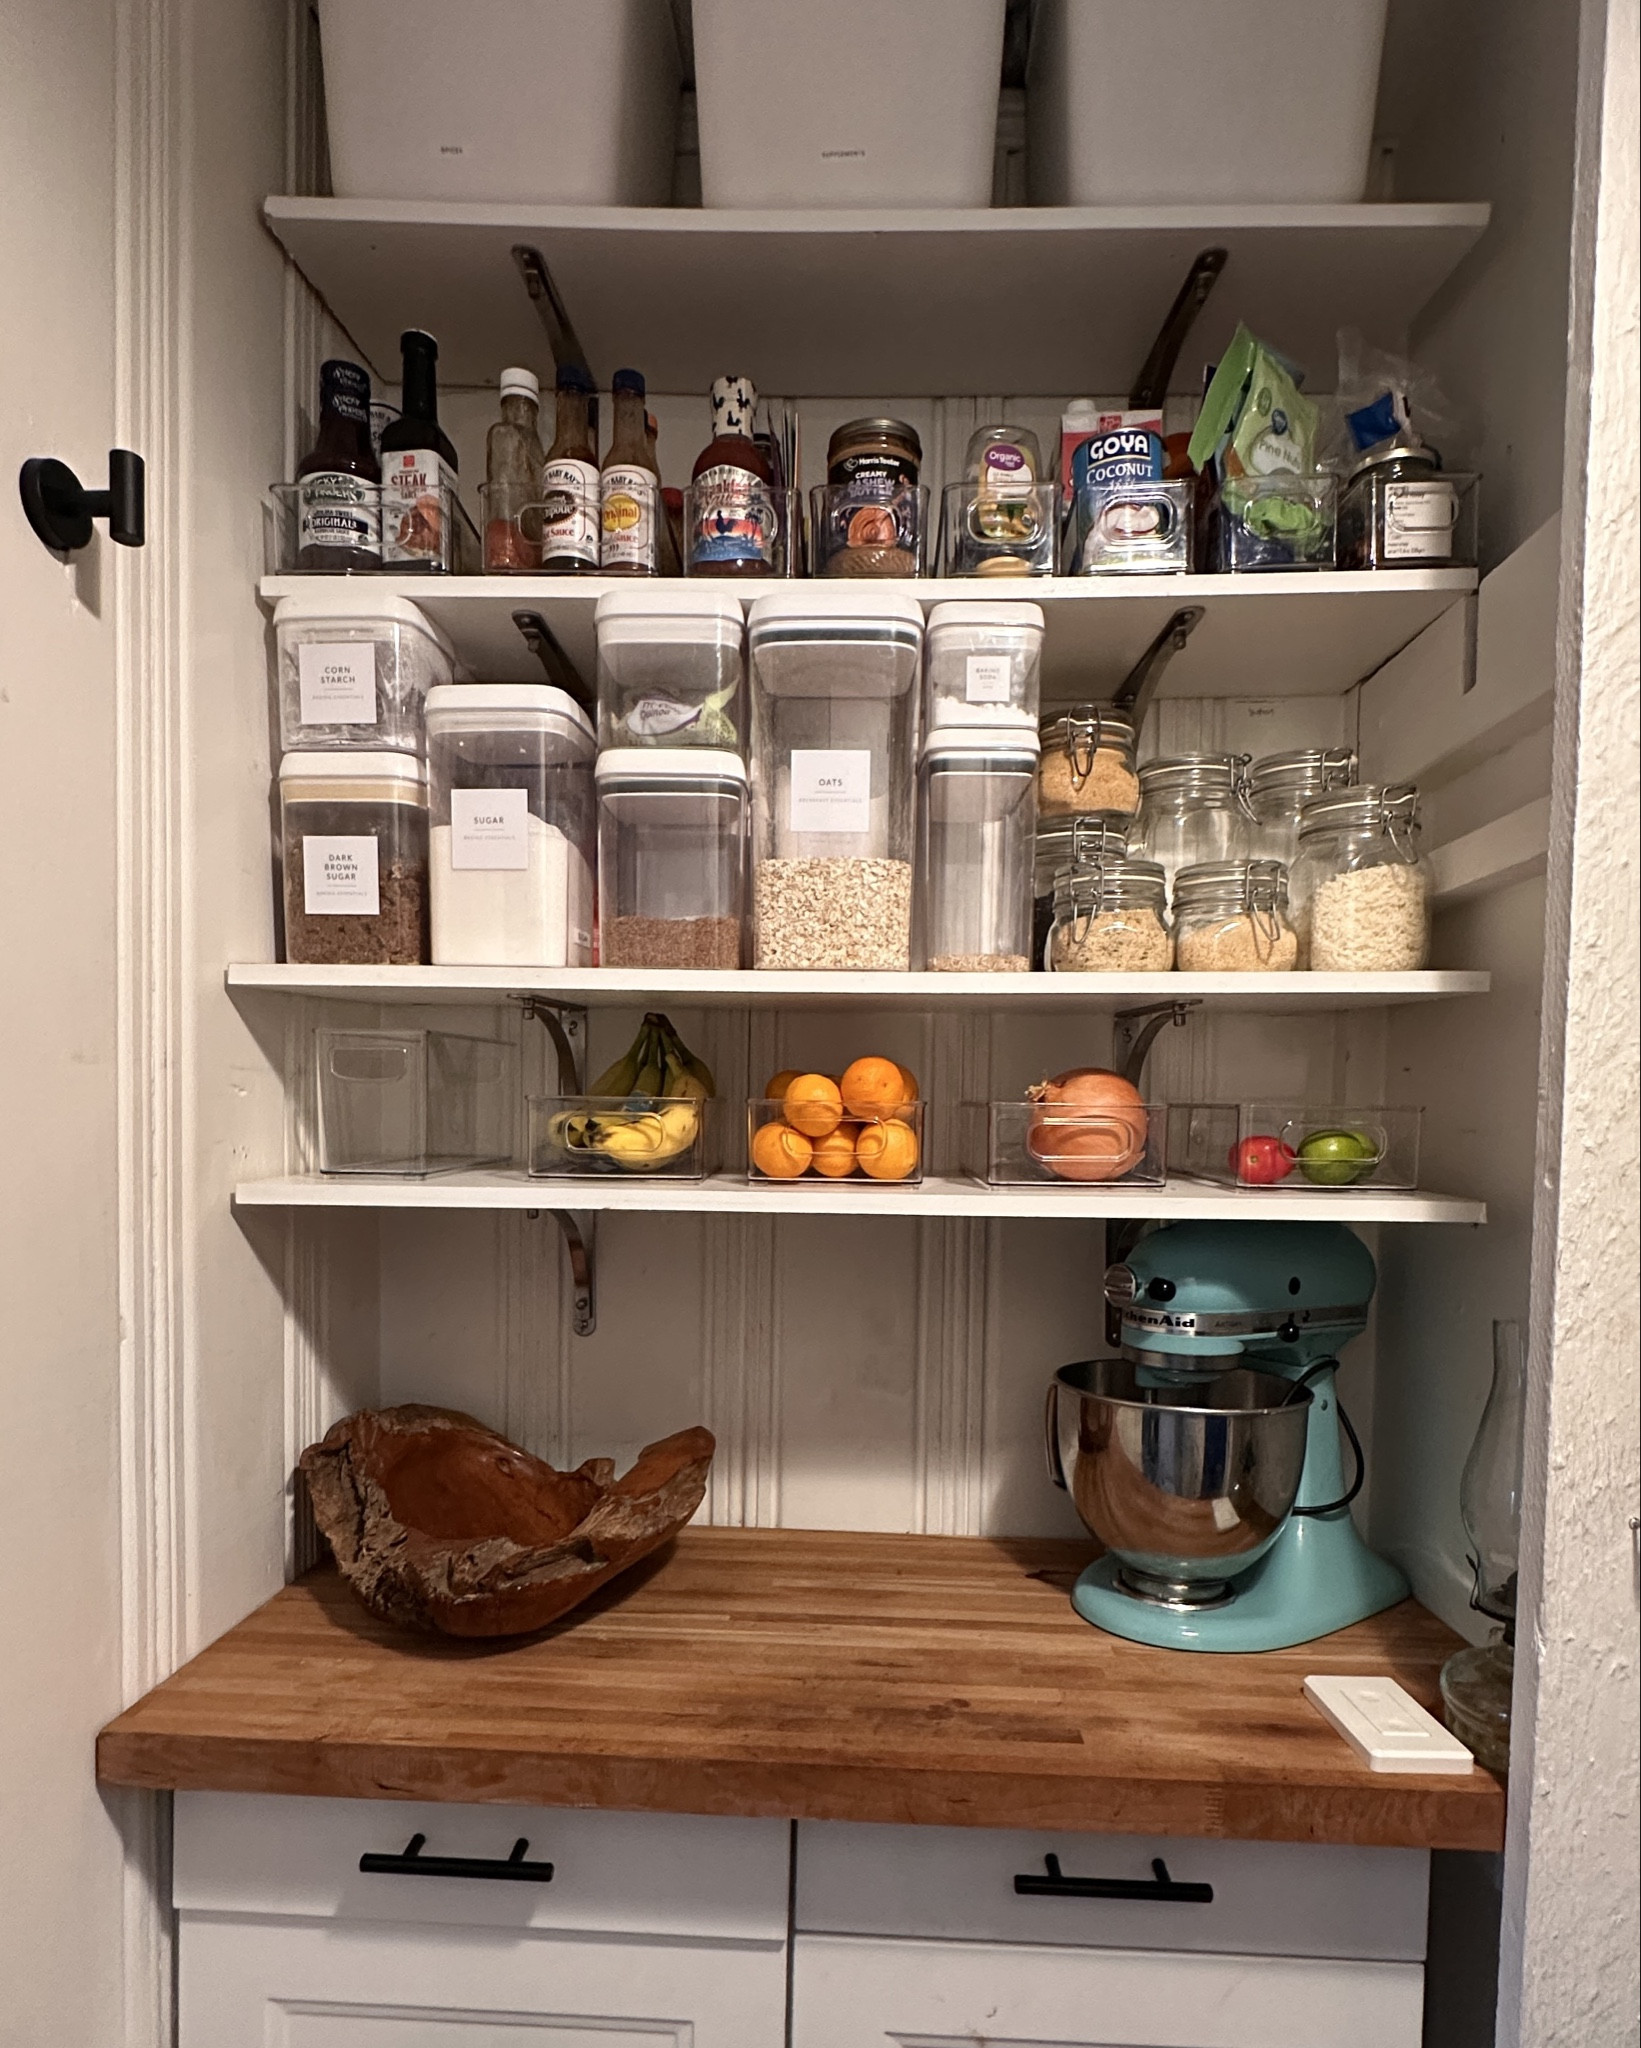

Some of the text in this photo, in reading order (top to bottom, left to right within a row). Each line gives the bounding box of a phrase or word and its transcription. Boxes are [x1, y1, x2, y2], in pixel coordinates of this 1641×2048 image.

[1090, 434, 1149, 460] GOYA
[989, 451, 1021, 463] Organic
[855, 471, 887, 479] CREAMY
[1086, 463, 1153, 484] COCONUT
[391, 473, 427, 487] STEAK
[550, 528, 575, 537] Sauce
[324, 666, 351, 674] CORN
[320, 675, 356, 684] STARCH
[818, 778, 843, 787] OATS
[473, 816, 505, 825] SUGAR
[328, 854, 353, 862] DARK
[324, 863, 359, 871] BROWN
[326, 872, 357, 881] SUGAR
